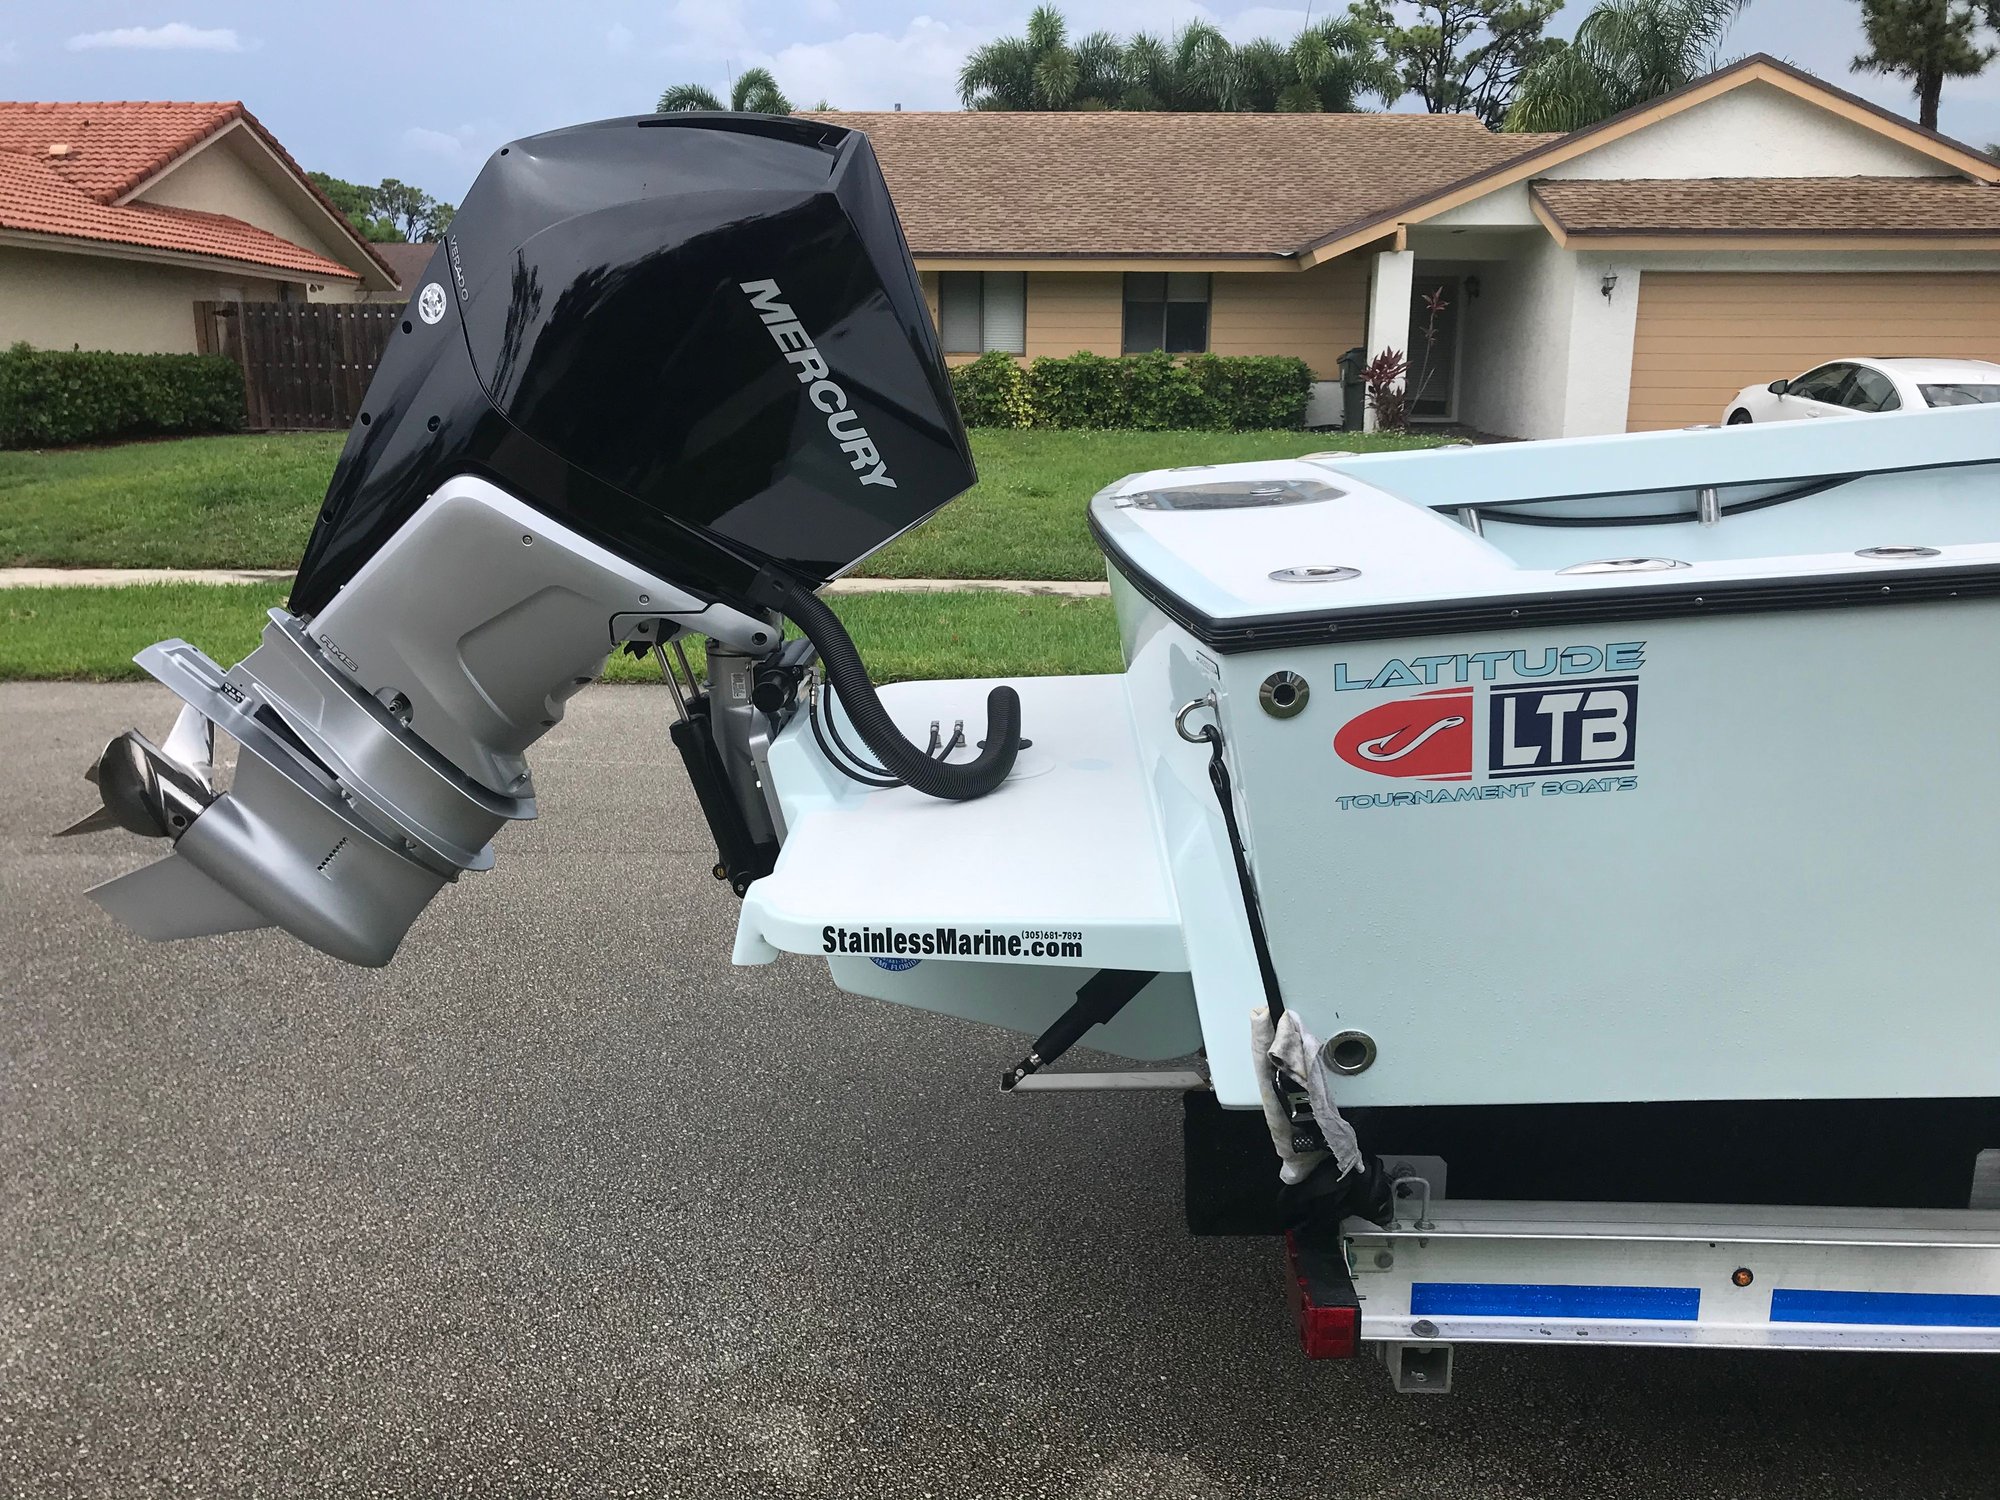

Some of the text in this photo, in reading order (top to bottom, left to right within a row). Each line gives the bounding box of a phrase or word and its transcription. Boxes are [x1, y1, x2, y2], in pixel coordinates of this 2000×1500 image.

[450, 234, 468, 300] VERADO
[739, 278, 898, 488] MERCURY
[1334, 641, 1647, 691] LATITUDE
[1502, 690, 1628, 766] LTB
[1335, 776, 1638, 810] TOURNAMENT BOATS
[822, 925, 1083, 958] StainlessMarine.com
[1021, 930, 1082, 940] (305)681-7893
